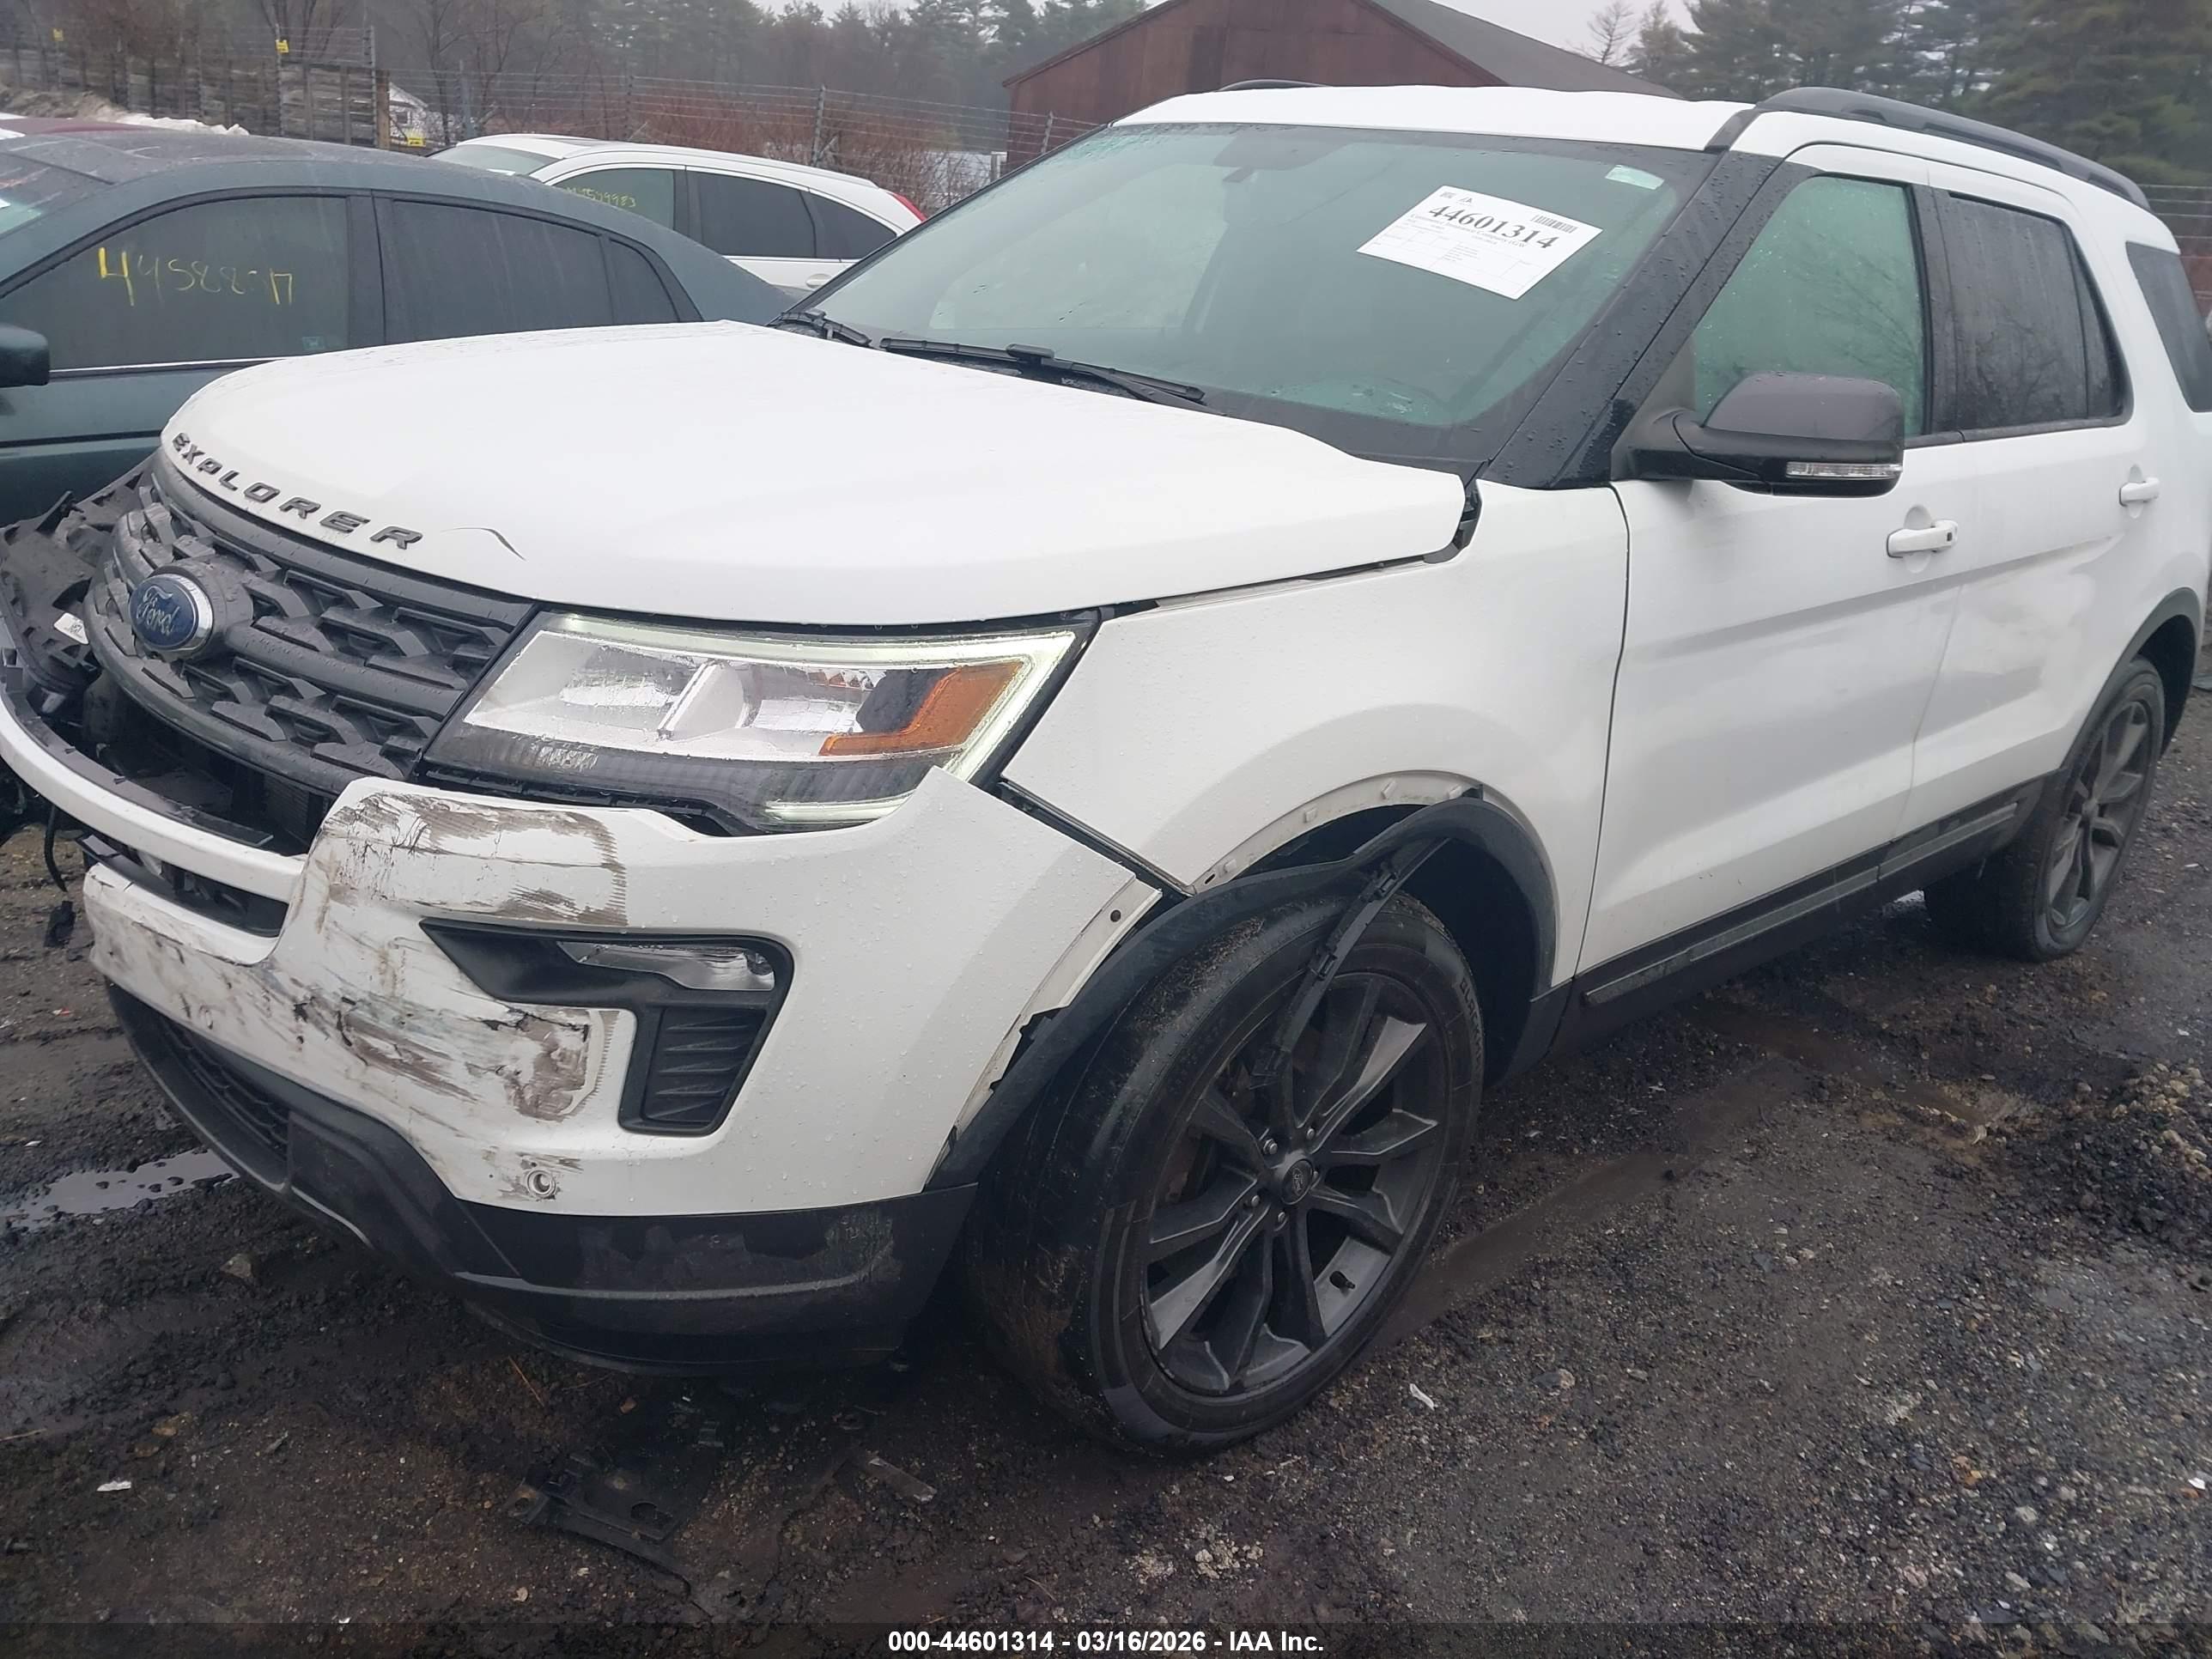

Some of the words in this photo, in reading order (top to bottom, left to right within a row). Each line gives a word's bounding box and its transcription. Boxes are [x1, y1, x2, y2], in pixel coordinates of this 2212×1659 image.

[1429, 205, 1559, 249] 44601314
[172, 432, 423, 550] EXPLORER
[137, 585, 181, 636] Ford
